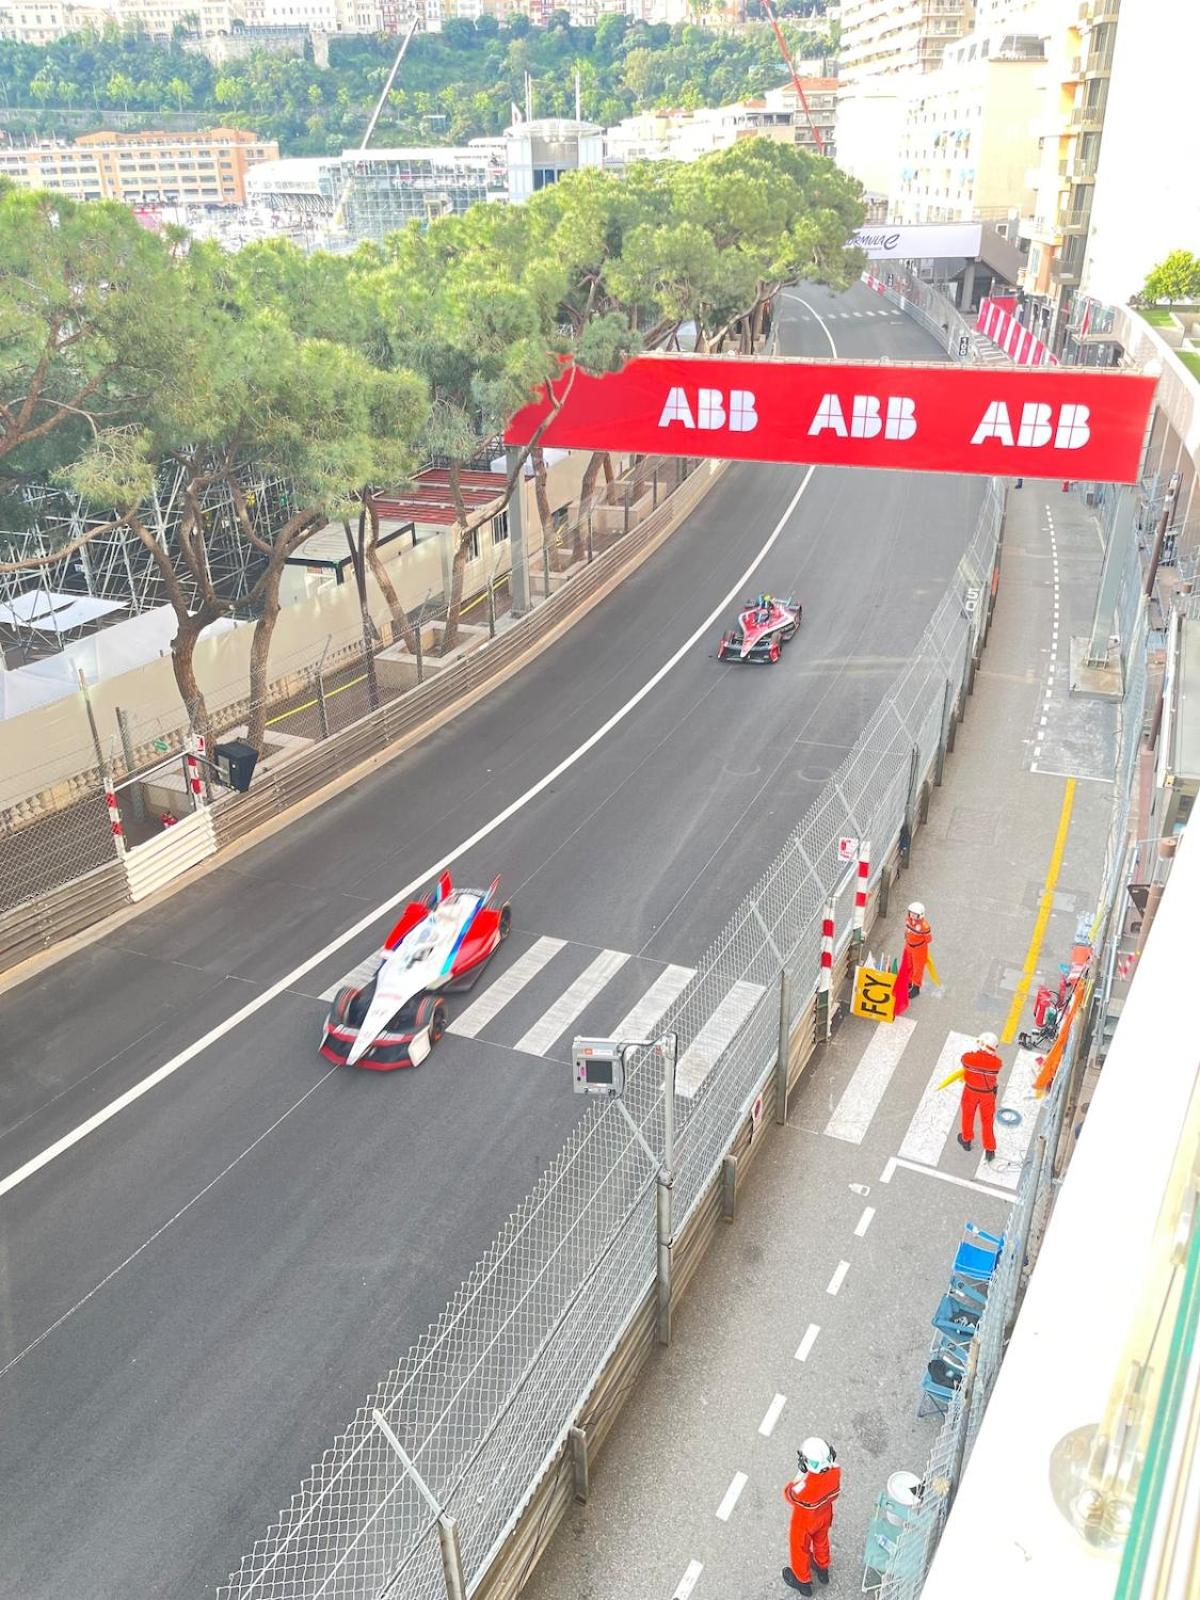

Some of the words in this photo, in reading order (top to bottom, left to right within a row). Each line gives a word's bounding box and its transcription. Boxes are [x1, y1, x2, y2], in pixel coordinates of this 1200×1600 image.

[844, 235, 886, 247] ORMULA
[658, 387, 758, 432] ABB
[807, 394, 917, 441] ABB
[970, 401, 1091, 449] ABB
[861, 974, 891, 1016] FCY
